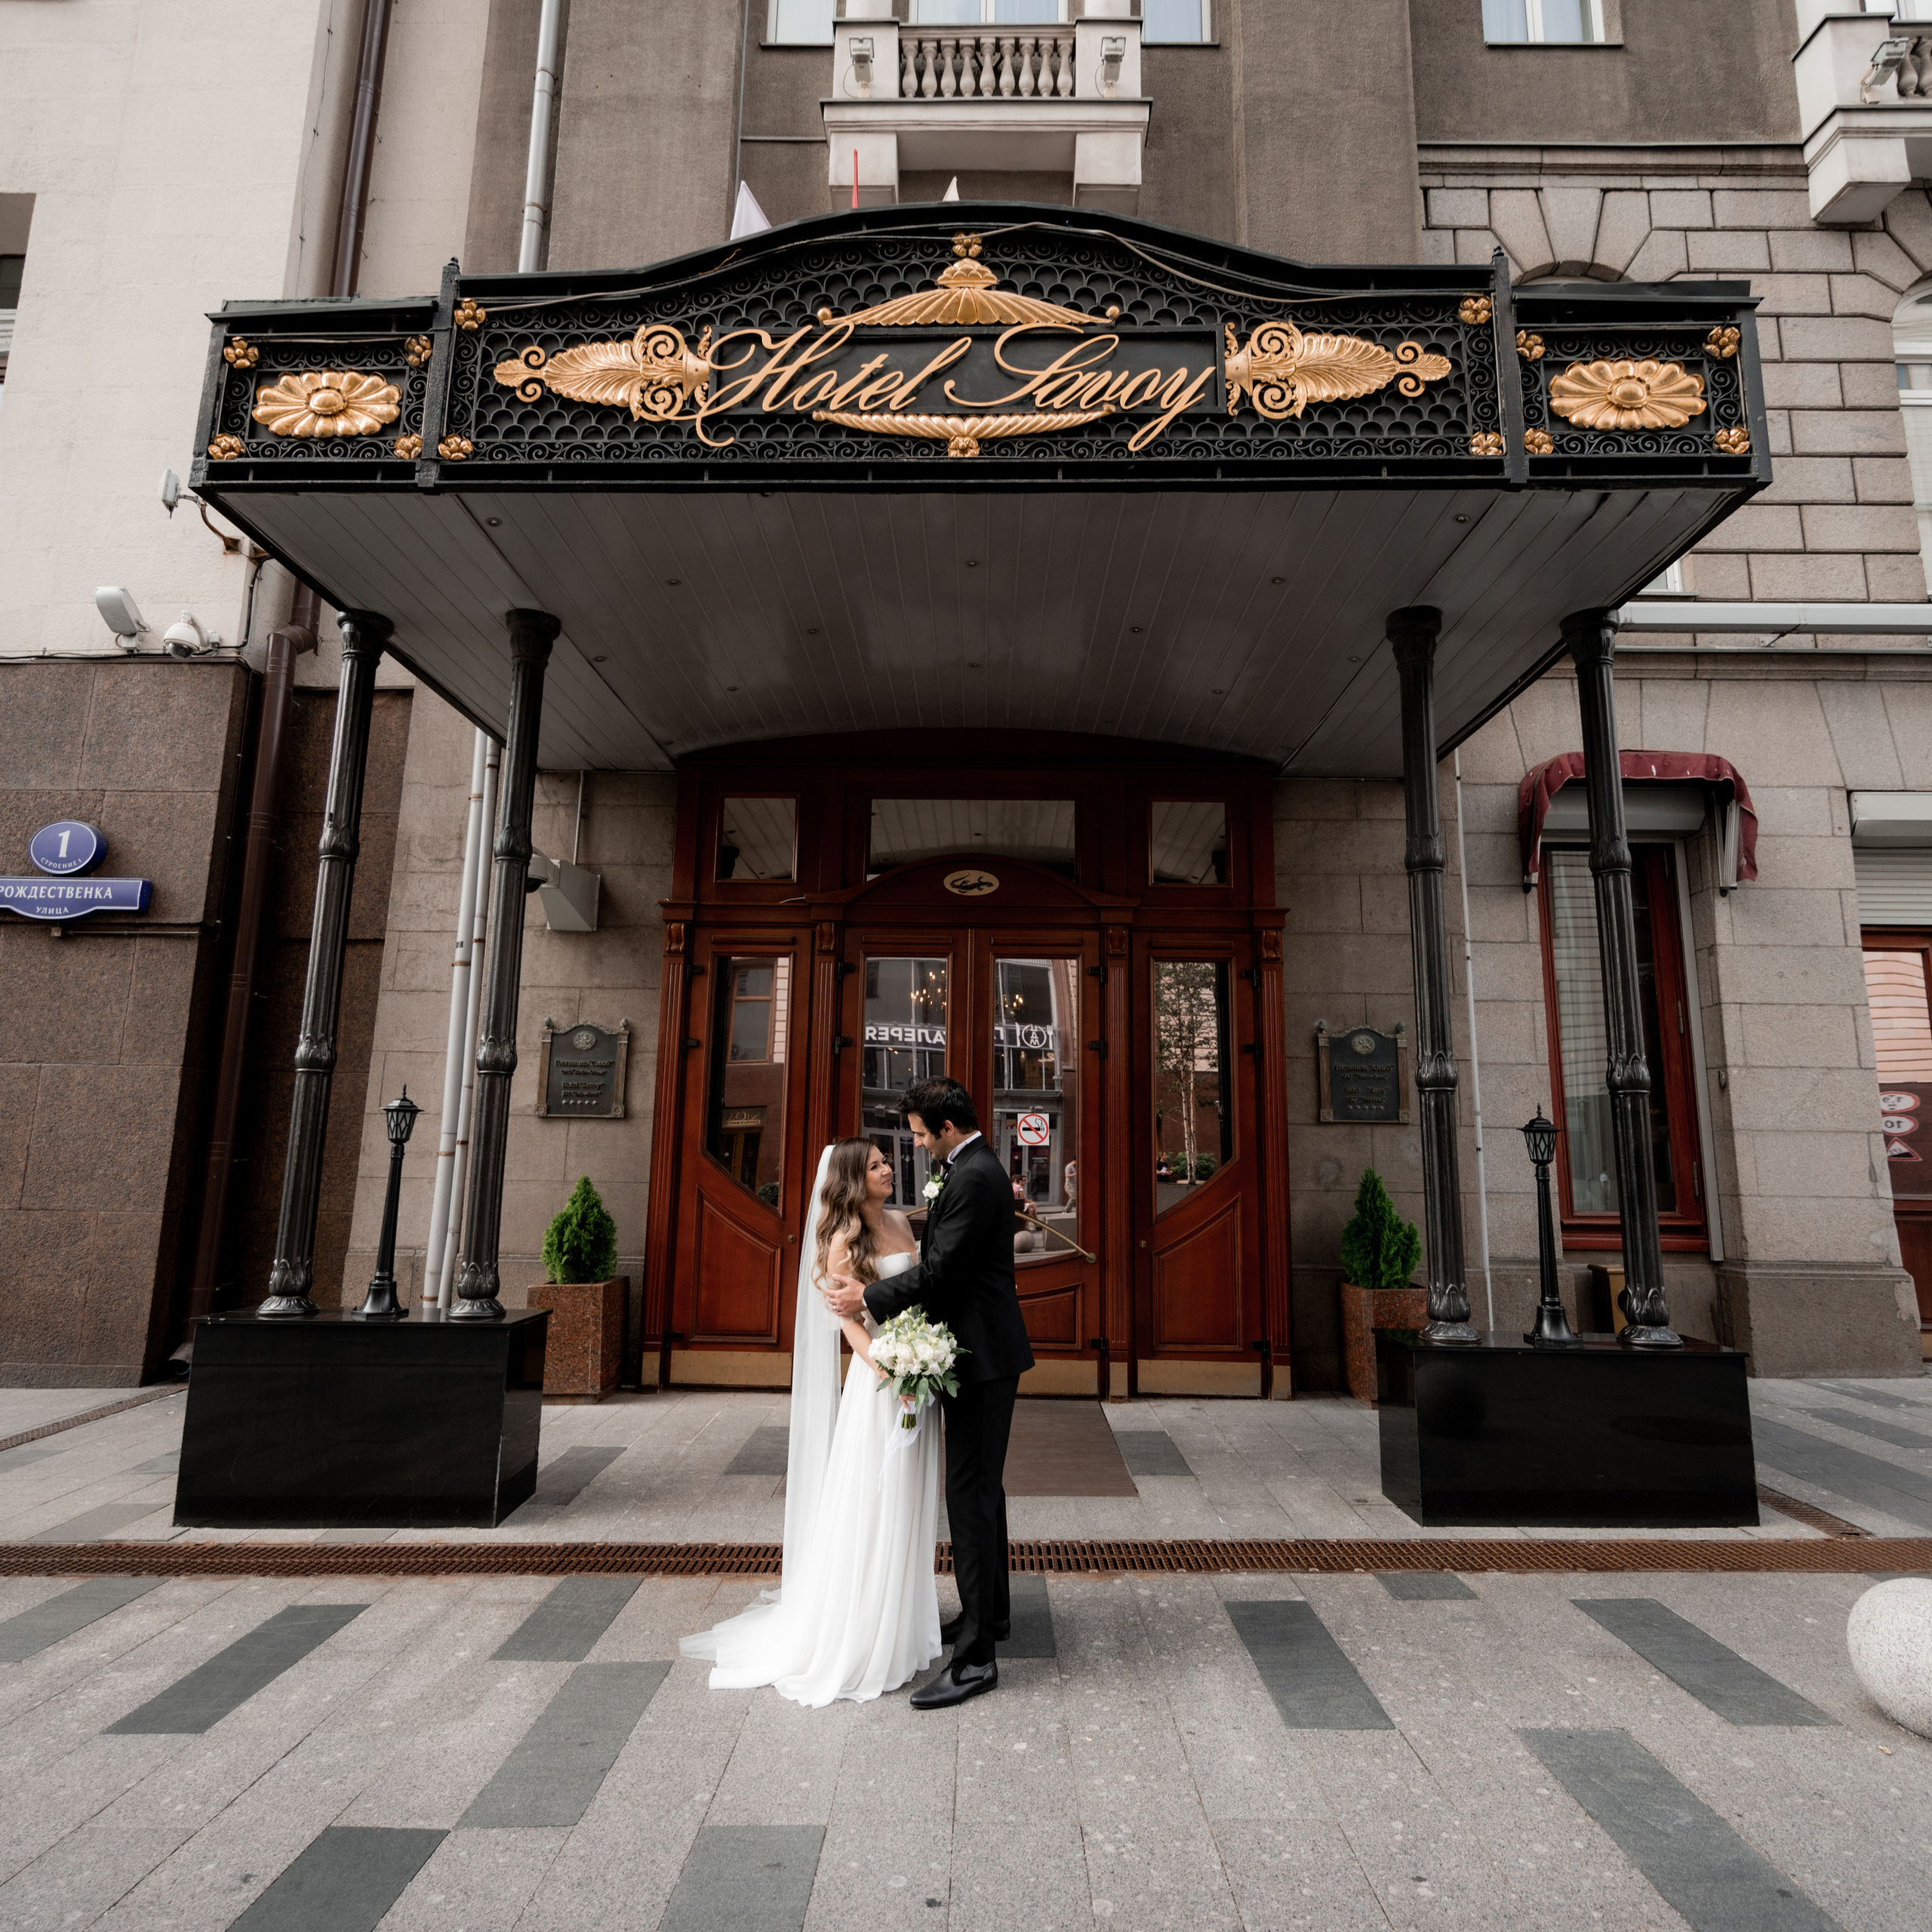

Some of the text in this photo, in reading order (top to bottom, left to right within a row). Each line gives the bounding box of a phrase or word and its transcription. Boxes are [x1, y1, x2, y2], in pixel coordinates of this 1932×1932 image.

[696, 321, 1215, 451] Hotel Savoy
[58, 830, 71, 858] 1
[40, 857, 78, 869] СТРОЕНИЕ
[36, 906, 69, 915] УЛИЦА
